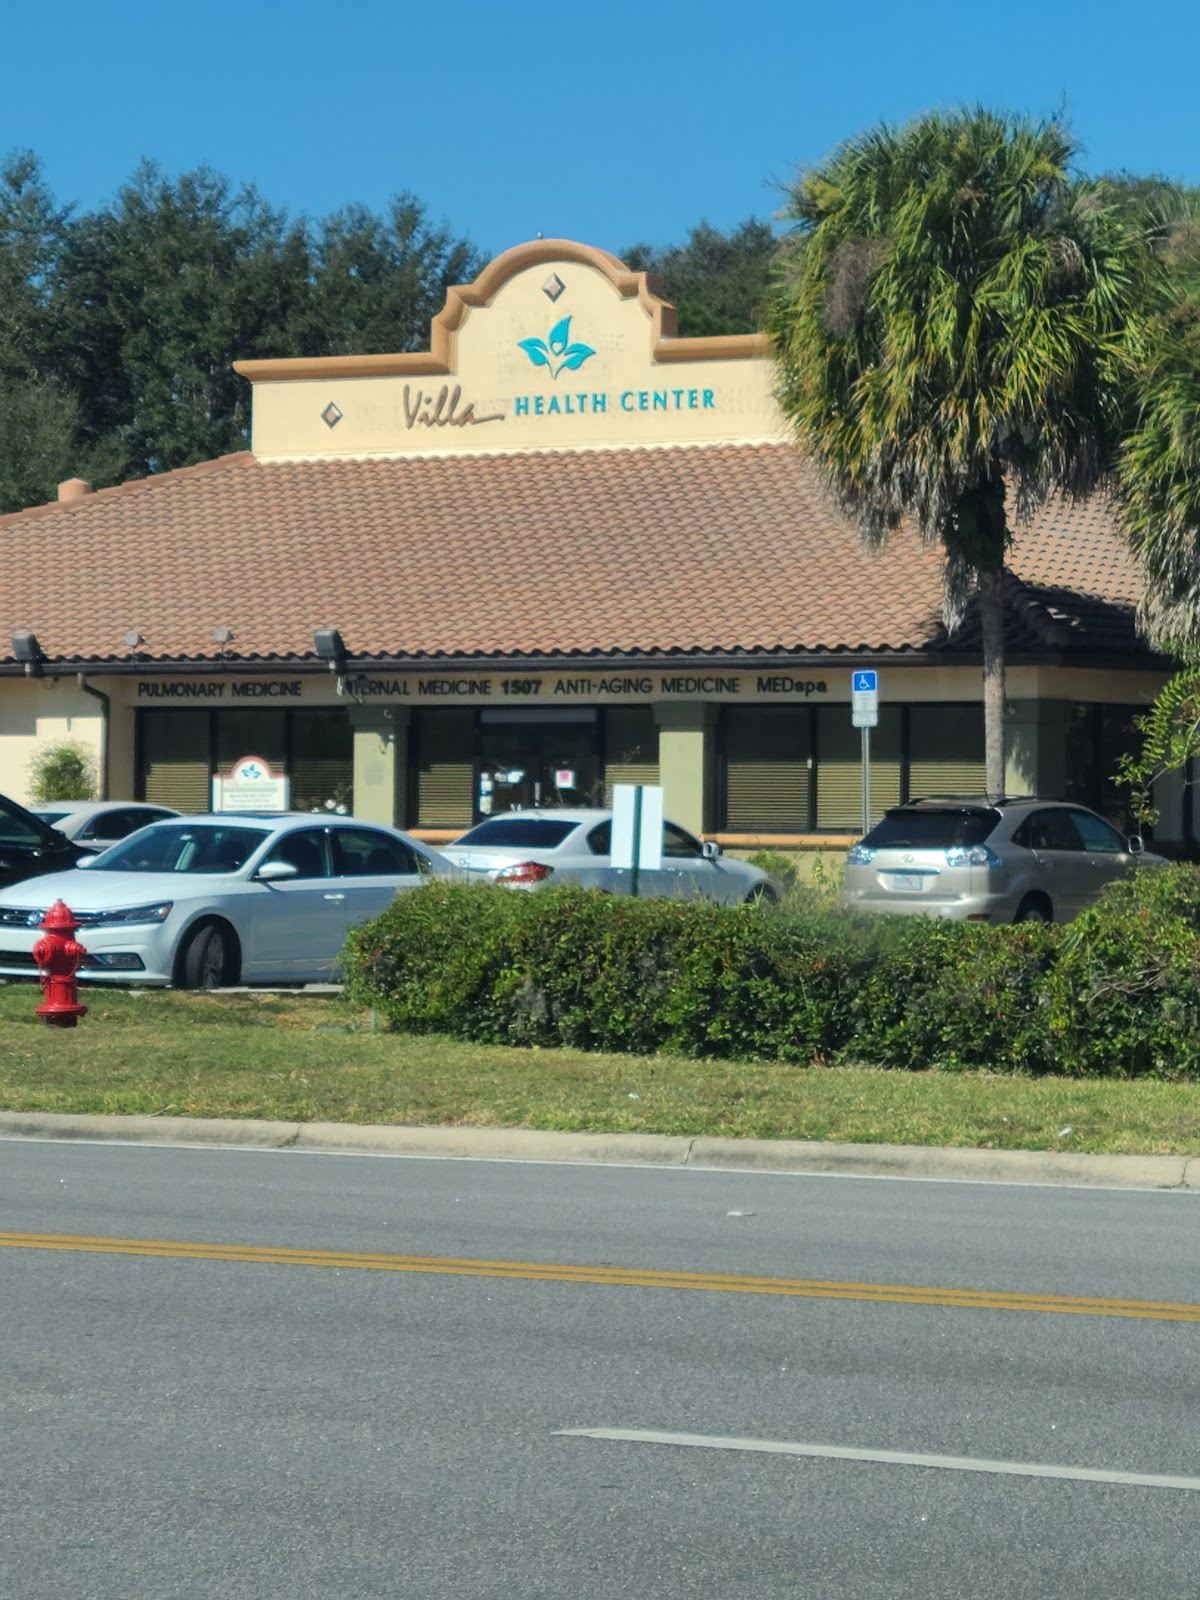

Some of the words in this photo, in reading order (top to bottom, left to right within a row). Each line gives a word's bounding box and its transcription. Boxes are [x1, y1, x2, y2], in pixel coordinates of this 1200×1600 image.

[402, 384, 505, 430] Villa
[514, 393, 607, 416] HEALTH
[619, 388, 717, 412] CENTER
[137, 681, 225, 697] PULMONARY
[231, 680, 302, 697] MEDICINE
[418, 678, 491, 697] MEDICINE
[500, 679, 542, 695] 1507
[554, 677, 653, 695] ANTI-AGING
[660, 677, 741, 694] MEDICINE
[756, 676, 828, 697] MEDspa
